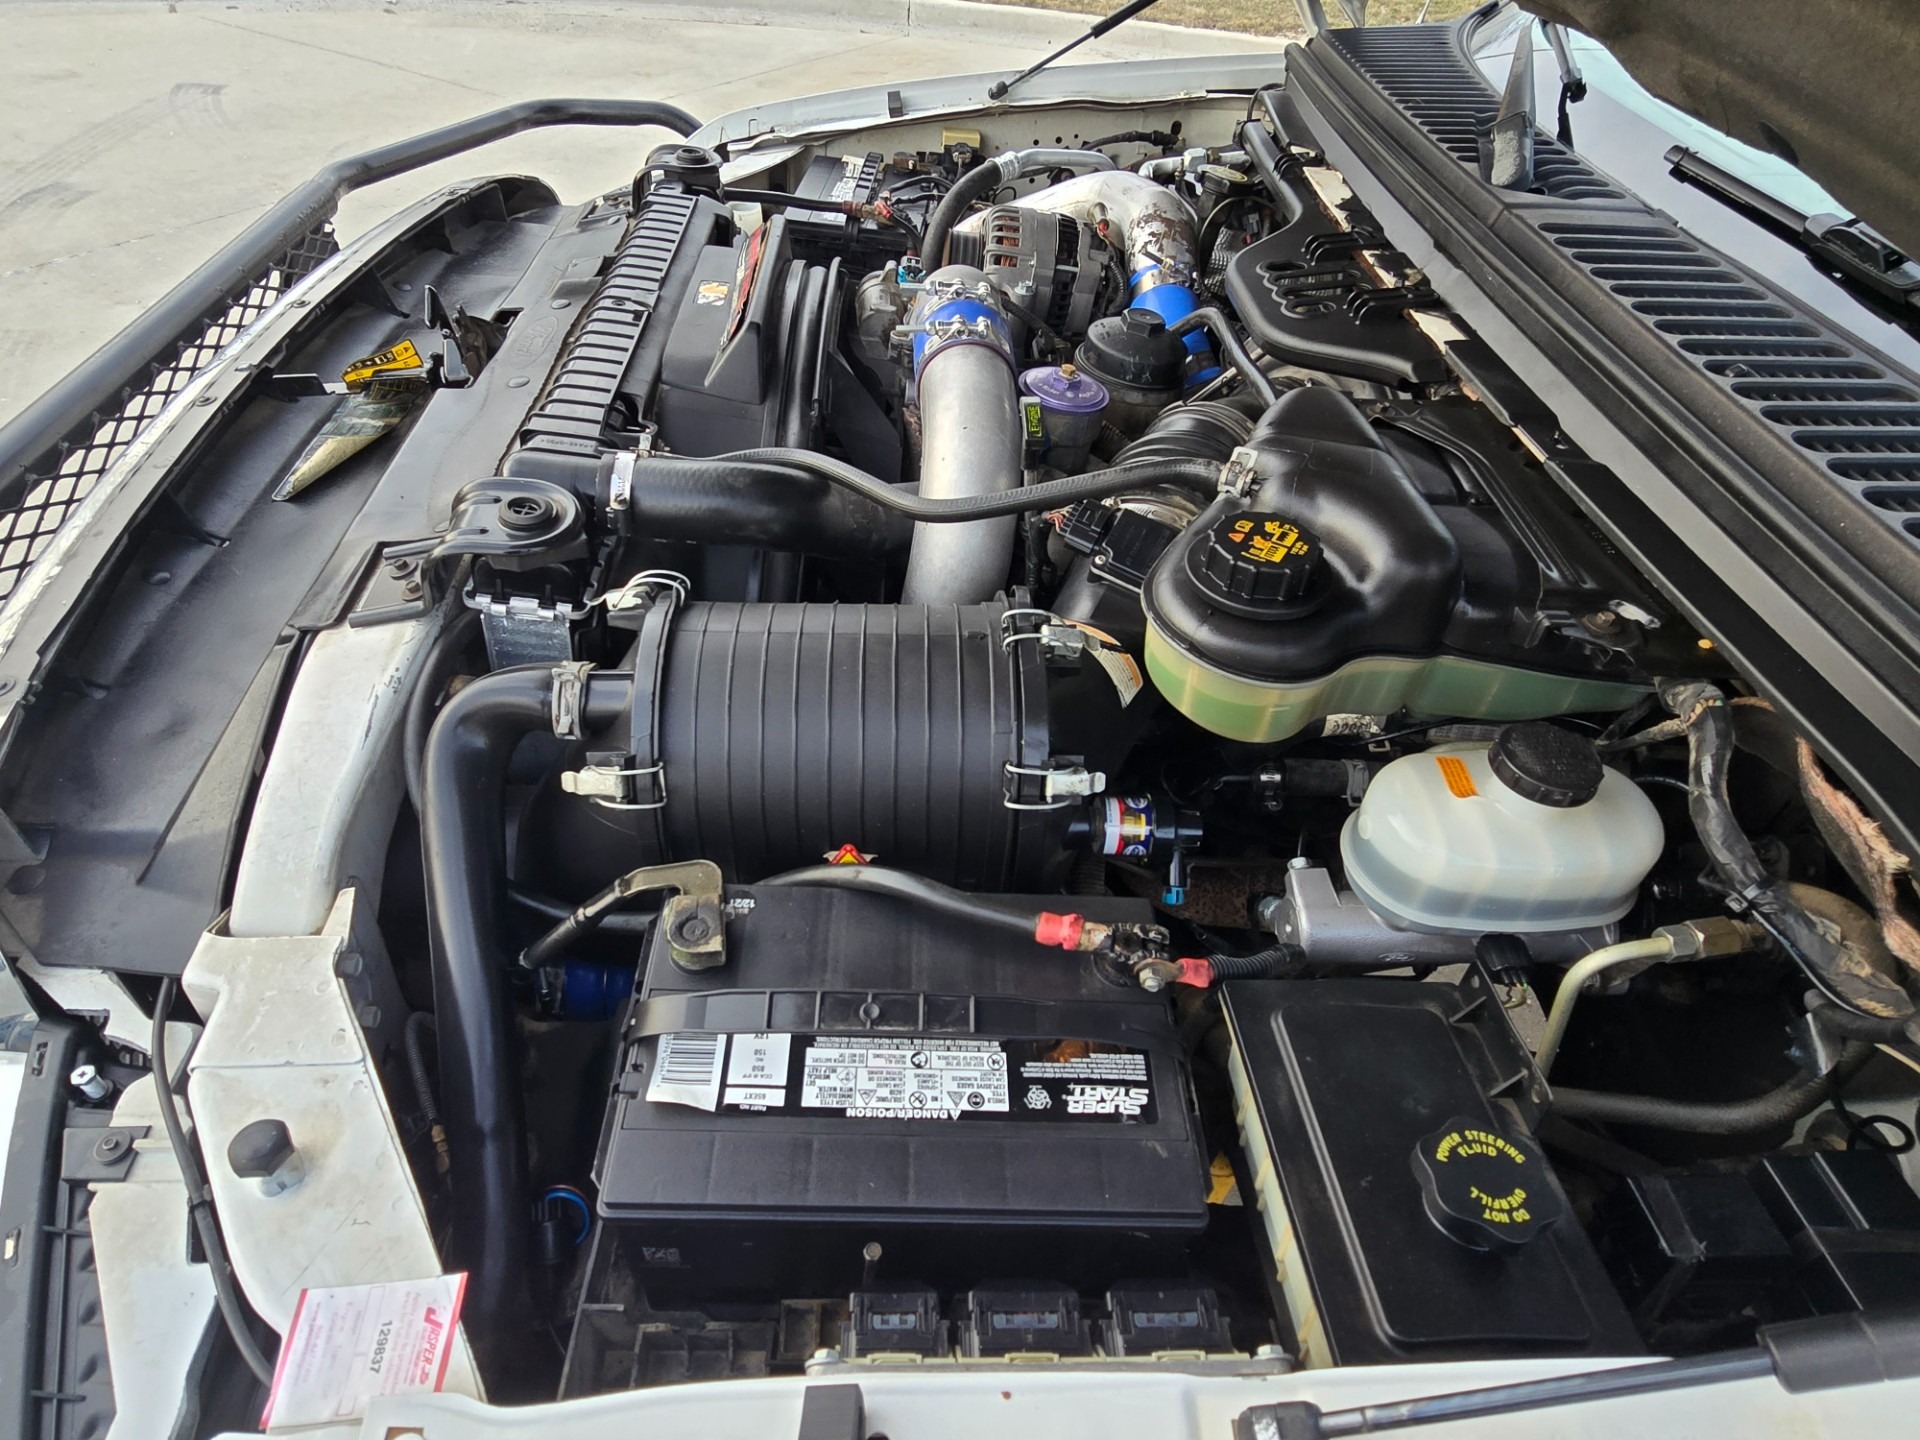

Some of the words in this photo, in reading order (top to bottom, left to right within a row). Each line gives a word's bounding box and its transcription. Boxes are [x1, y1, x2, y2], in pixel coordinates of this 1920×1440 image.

[730, 898, 756, 909] 12/21
[754, 1048, 766, 1056] 150
[744, 1092, 766, 1100] 65EXT
[1066, 1087, 1149, 1105] START
[846, 1108, 948, 1119] DANGER/POISON
[1067, 1100, 1141, 1115] SUPER
[1436, 1132, 1462, 1162] POWER
[1464, 1130, 1526, 1164] STEERING
[1457, 1142, 1498, 1158] FLUID
[1469, 1186, 1528, 1210] OVERFILL
[1482, 1208, 1510, 1224] NOT
[1512, 1208, 1532, 1223] DO
[420, 1307, 442, 1365] JASPER
[370, 1320, 392, 1374] 129837
